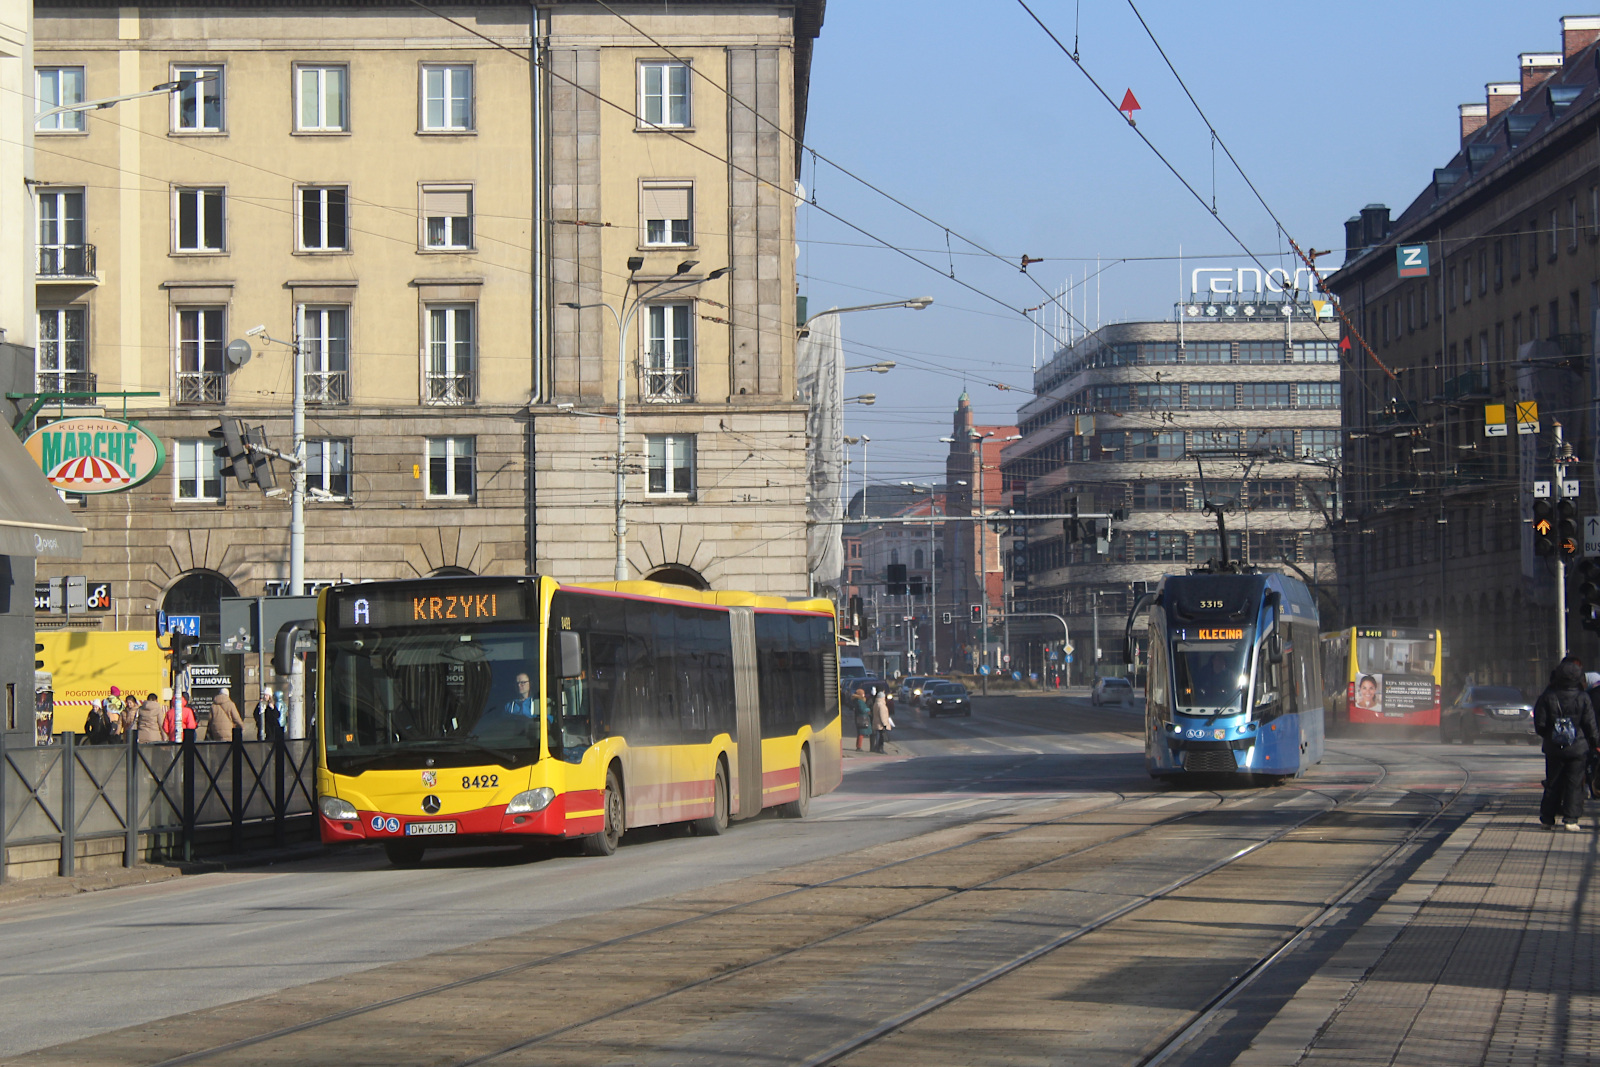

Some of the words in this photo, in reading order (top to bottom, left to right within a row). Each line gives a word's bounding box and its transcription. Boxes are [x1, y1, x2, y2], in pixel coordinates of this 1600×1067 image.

[1403, 248, 1422, 266] Z
[354, 599, 370, 625] A
[413, 594, 497, 621] KRZYKI
[1200, 600, 1223, 608] 3315
[1198, 629, 1243, 640] KLECINA
[462, 775, 499, 789] 8422
